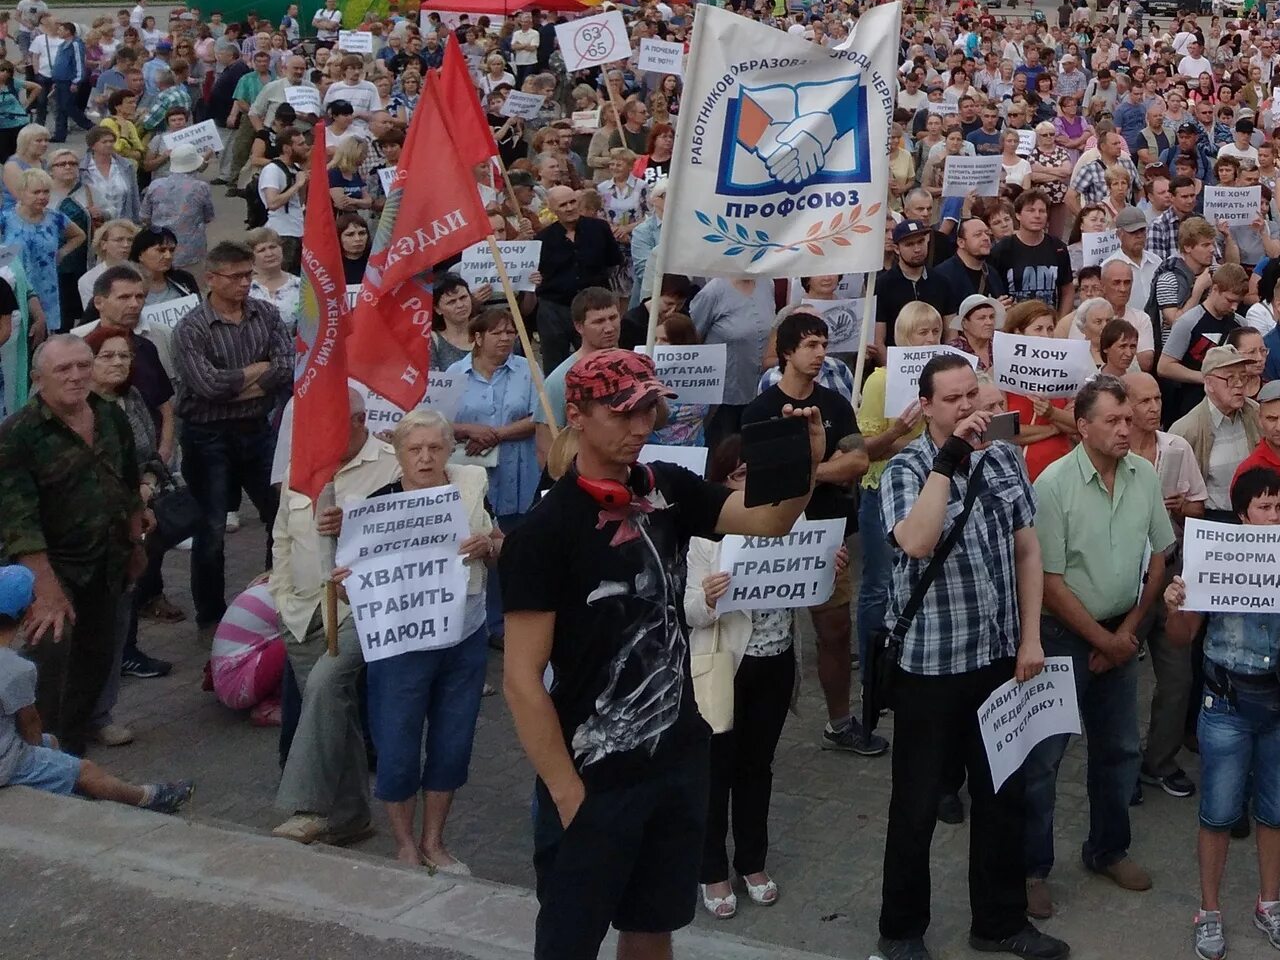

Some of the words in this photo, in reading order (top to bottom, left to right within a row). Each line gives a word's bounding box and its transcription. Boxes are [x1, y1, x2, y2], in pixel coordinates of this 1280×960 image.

[582, 26, 602, 42] 63
[587, 42, 607, 57] 65
[651, 46, 680, 55] ПОЧЕМУ
[691, 74, 736, 165] РАБОТНИКОВ
[725, 190, 860, 218] ПРОФСОЮЗ
[1214, 212, 1249, 220] РАБОТЕ!
[1097, 236, 1108, 244] ЗА
[1090, 246, 1110, 256] МНЕ
[314, 297, 339, 367] ЖЕНСКИЙ
[657, 351, 700, 362] ПОЗОР
[1014, 344, 1028, 357] Я
[1010, 364, 1068, 378] ДОЖИТЬ
[1000, 375, 1016, 386] ДО
[1020, 381, 1079, 393] ПЕНСИИ!
[348, 491, 461, 520] ПРАВИТЕЛЬСТВ
[362, 512, 453, 536] МЕДВЕДЕВА
[359, 546, 368, 558] В
[373, 534, 449, 554] ОТСТАВКУ
[741, 530, 827, 549] ХВАТИТ
[732, 556, 827, 576] ГРАБИТЬ
[1205, 551, 1276, 564] РЕФОРМА
[358, 558, 449, 590] ХВАТИТ
[732, 582, 806, 600] НАРОД
[356, 588, 455, 622] ГРАБИТЬ
[1210, 595, 1275, 608] НАРОДА!
[366, 618, 436, 650] НАРОД
[992, 681, 1056, 732] МЕДВЕДЕВА
[996, 740, 1003, 752] В
[1004, 698, 1056, 744] ОТСТАВКУ
